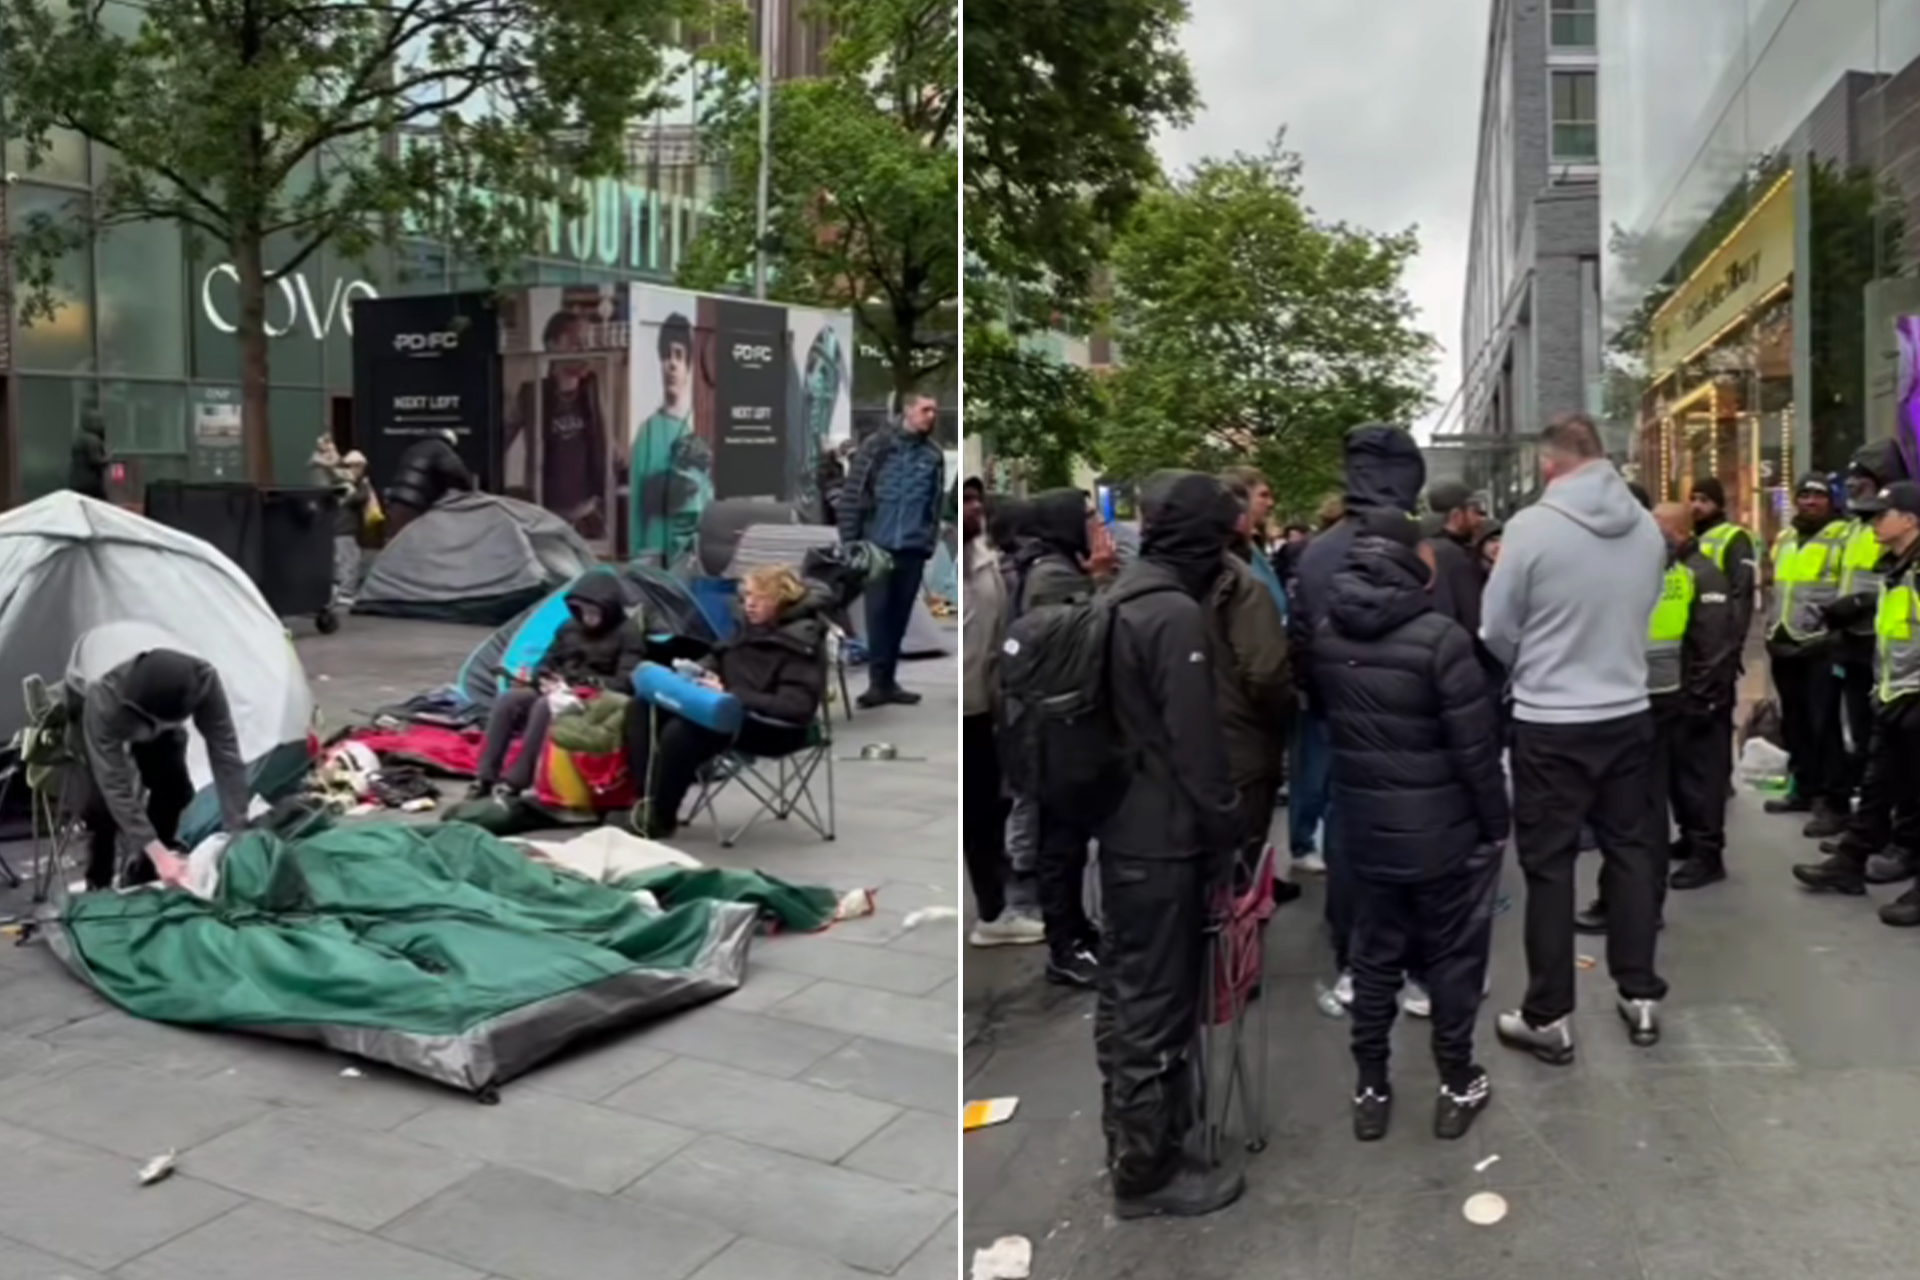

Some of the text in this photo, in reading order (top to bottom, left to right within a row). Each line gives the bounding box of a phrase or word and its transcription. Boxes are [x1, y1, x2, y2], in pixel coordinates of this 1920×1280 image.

[394, 396, 460, 409] NEXT LEFT
[731, 406, 771, 420] NEXT LEFT
